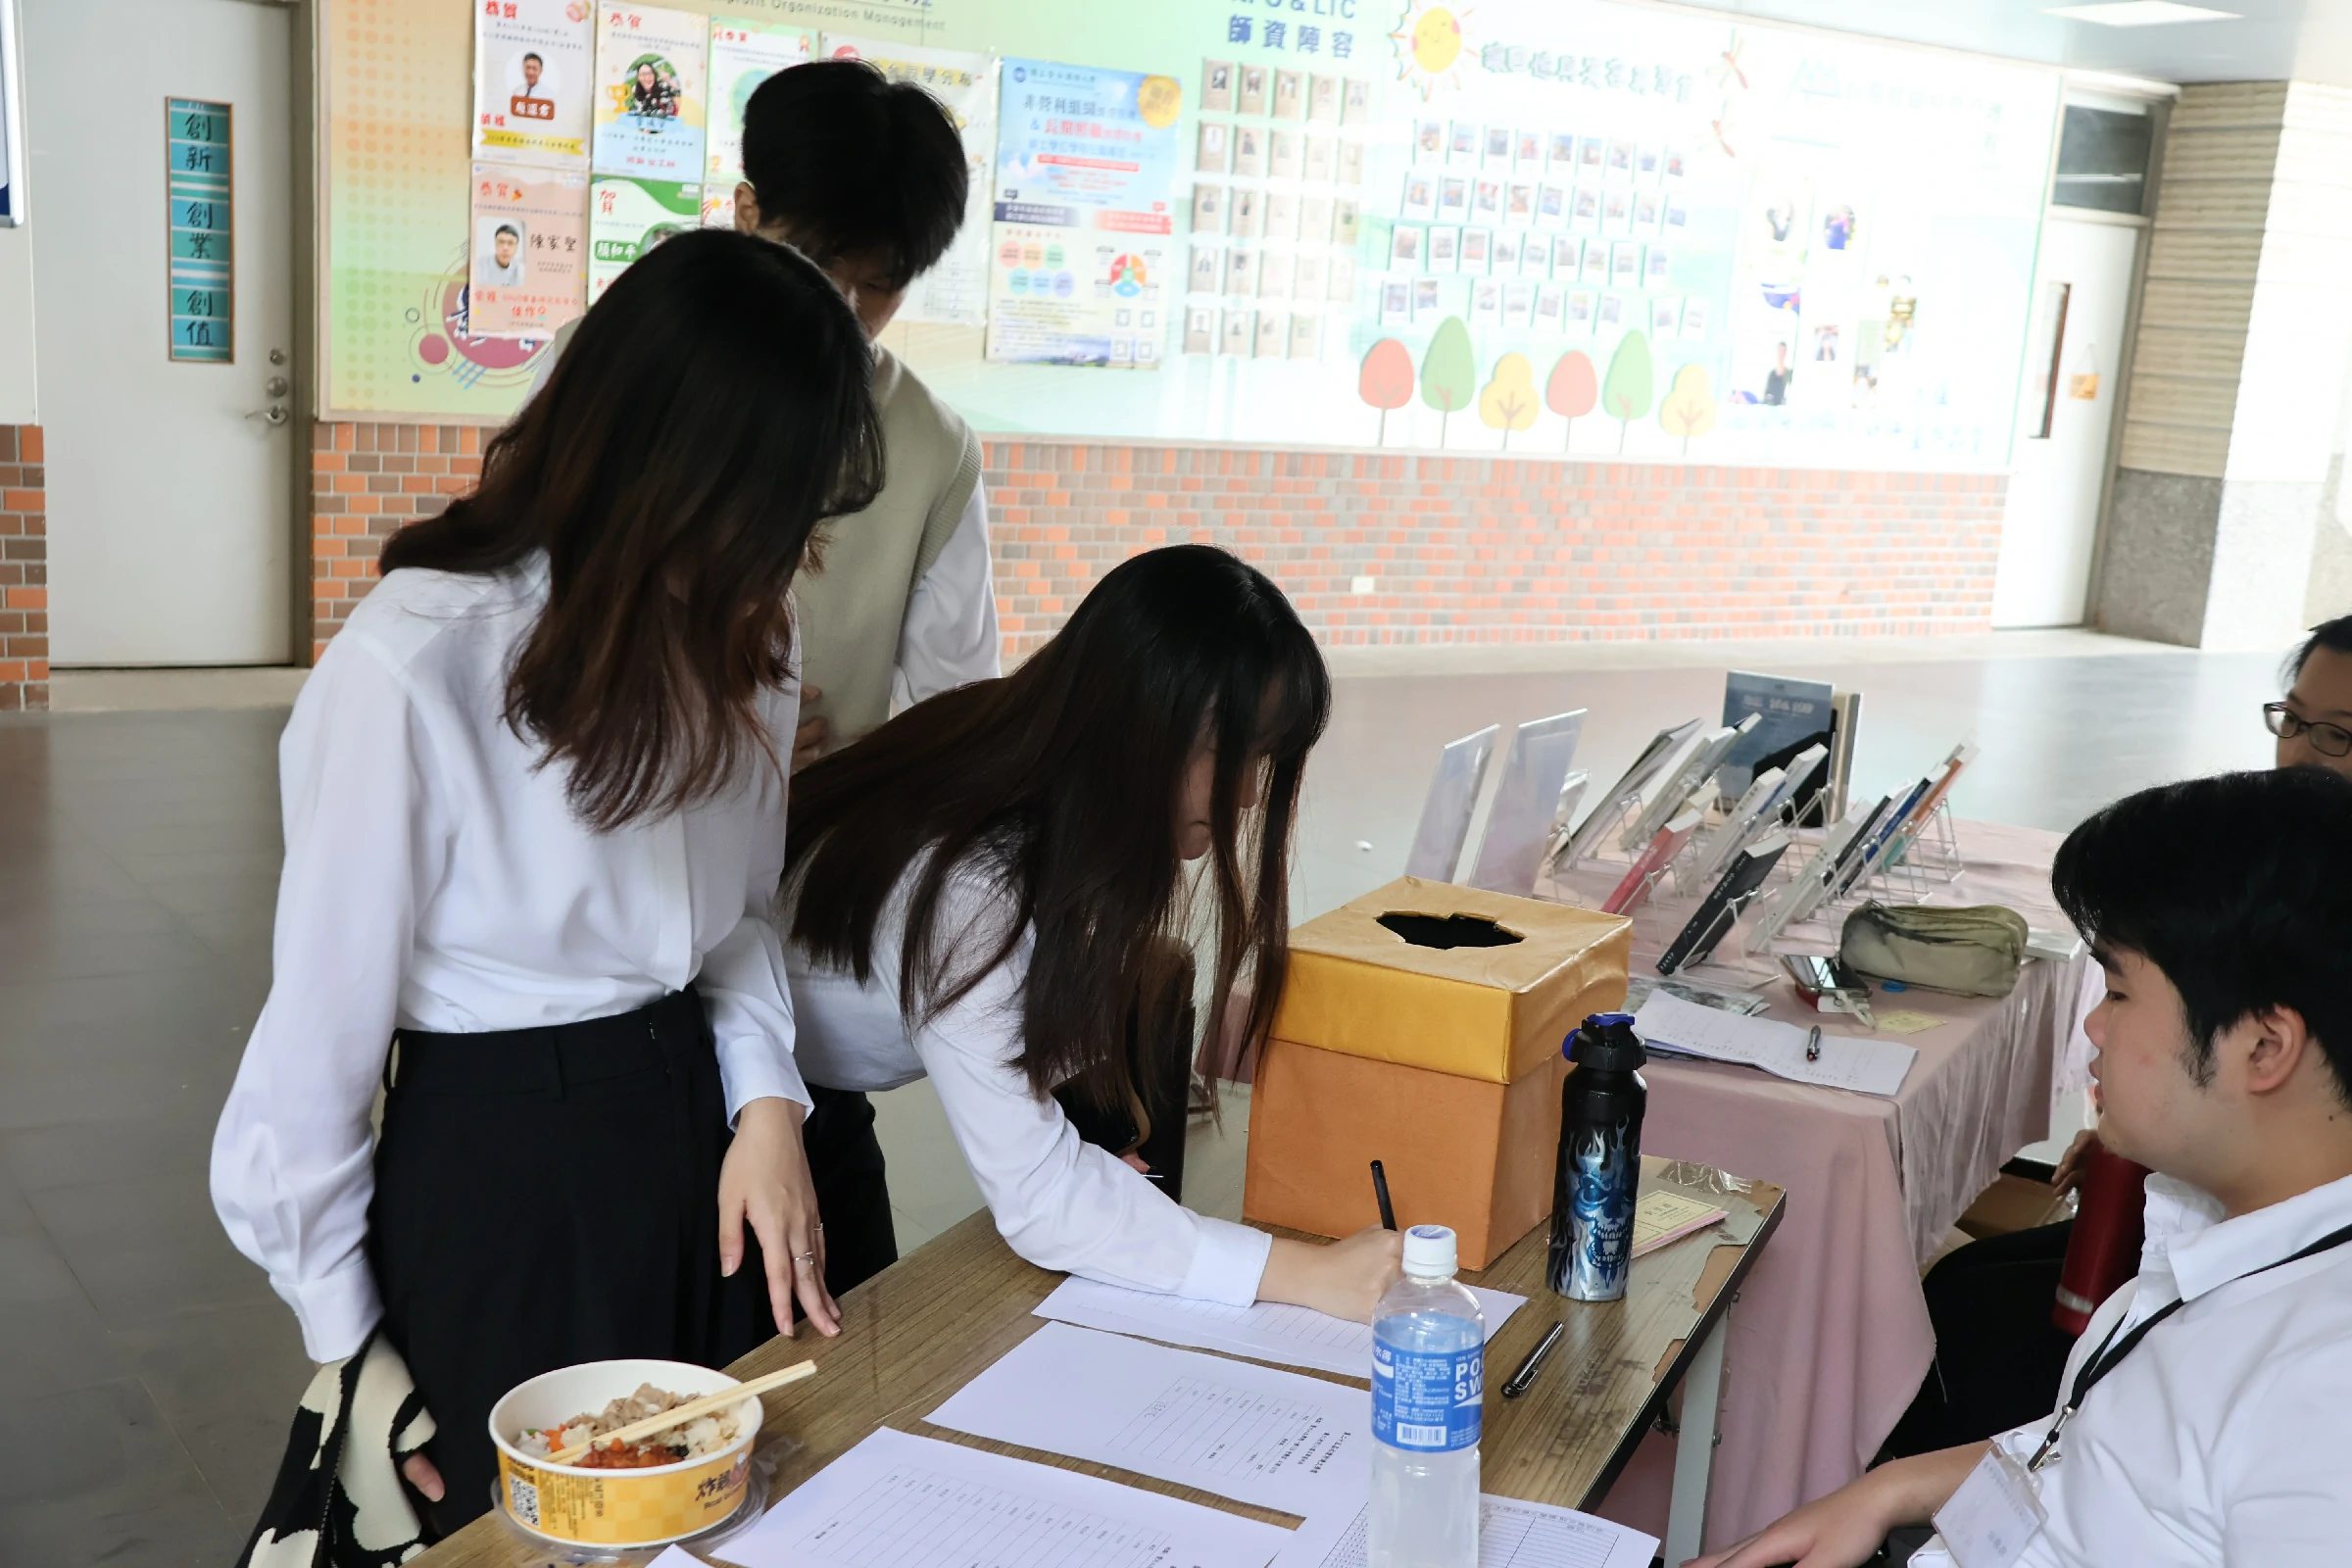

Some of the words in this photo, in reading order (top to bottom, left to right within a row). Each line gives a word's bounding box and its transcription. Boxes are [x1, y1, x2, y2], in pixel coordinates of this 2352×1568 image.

[1228, 14, 1353, 58] 師資陣容
[186, 113, 213, 172] 創新
[599, 189, 615, 215] 賀
[186, 201, 213, 259] 創業
[186, 290, 213, 346] 創值
[1454, 1376, 1483, 1401] SW
[1455, 1352, 1484, 1383] PO
